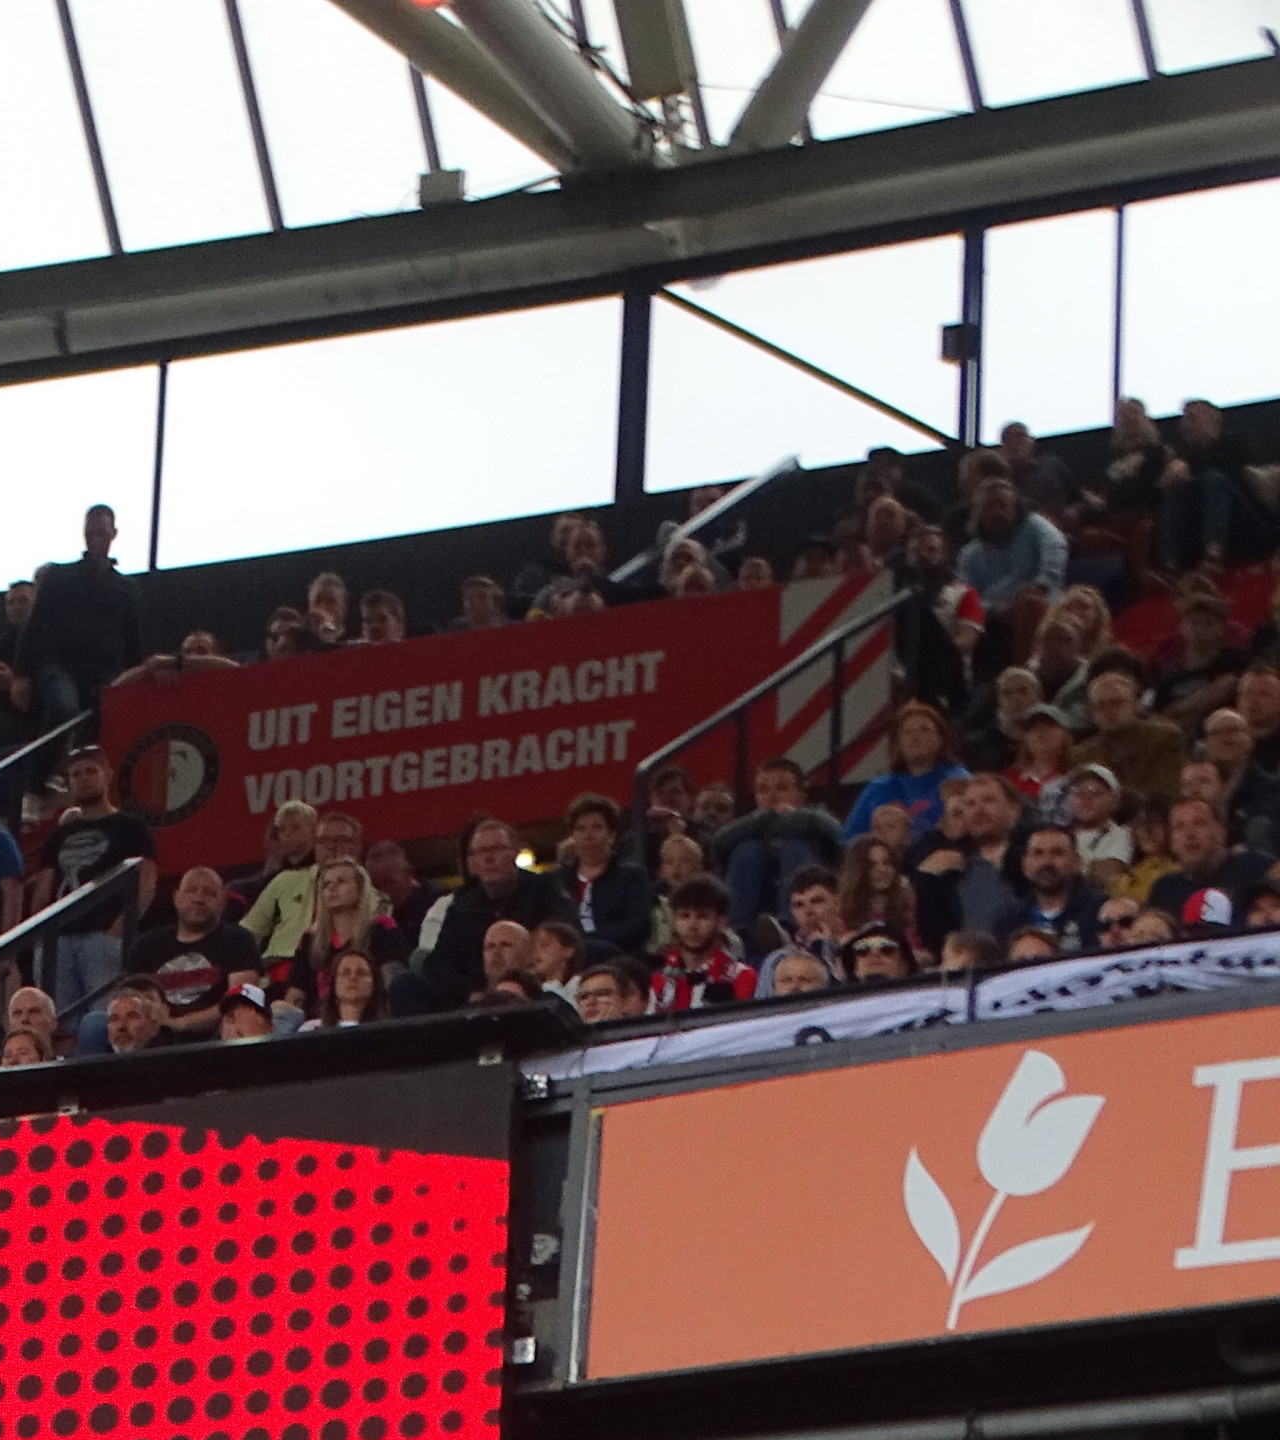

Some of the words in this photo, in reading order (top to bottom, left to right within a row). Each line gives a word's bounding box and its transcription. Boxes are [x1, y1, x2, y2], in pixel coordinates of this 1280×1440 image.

[247, 703, 319, 752] UIT
[331, 680, 464, 740] EIGEN
[477, 649, 666, 718] KRACHT
[243, 719, 637, 815] VOORTGEBRACHT
